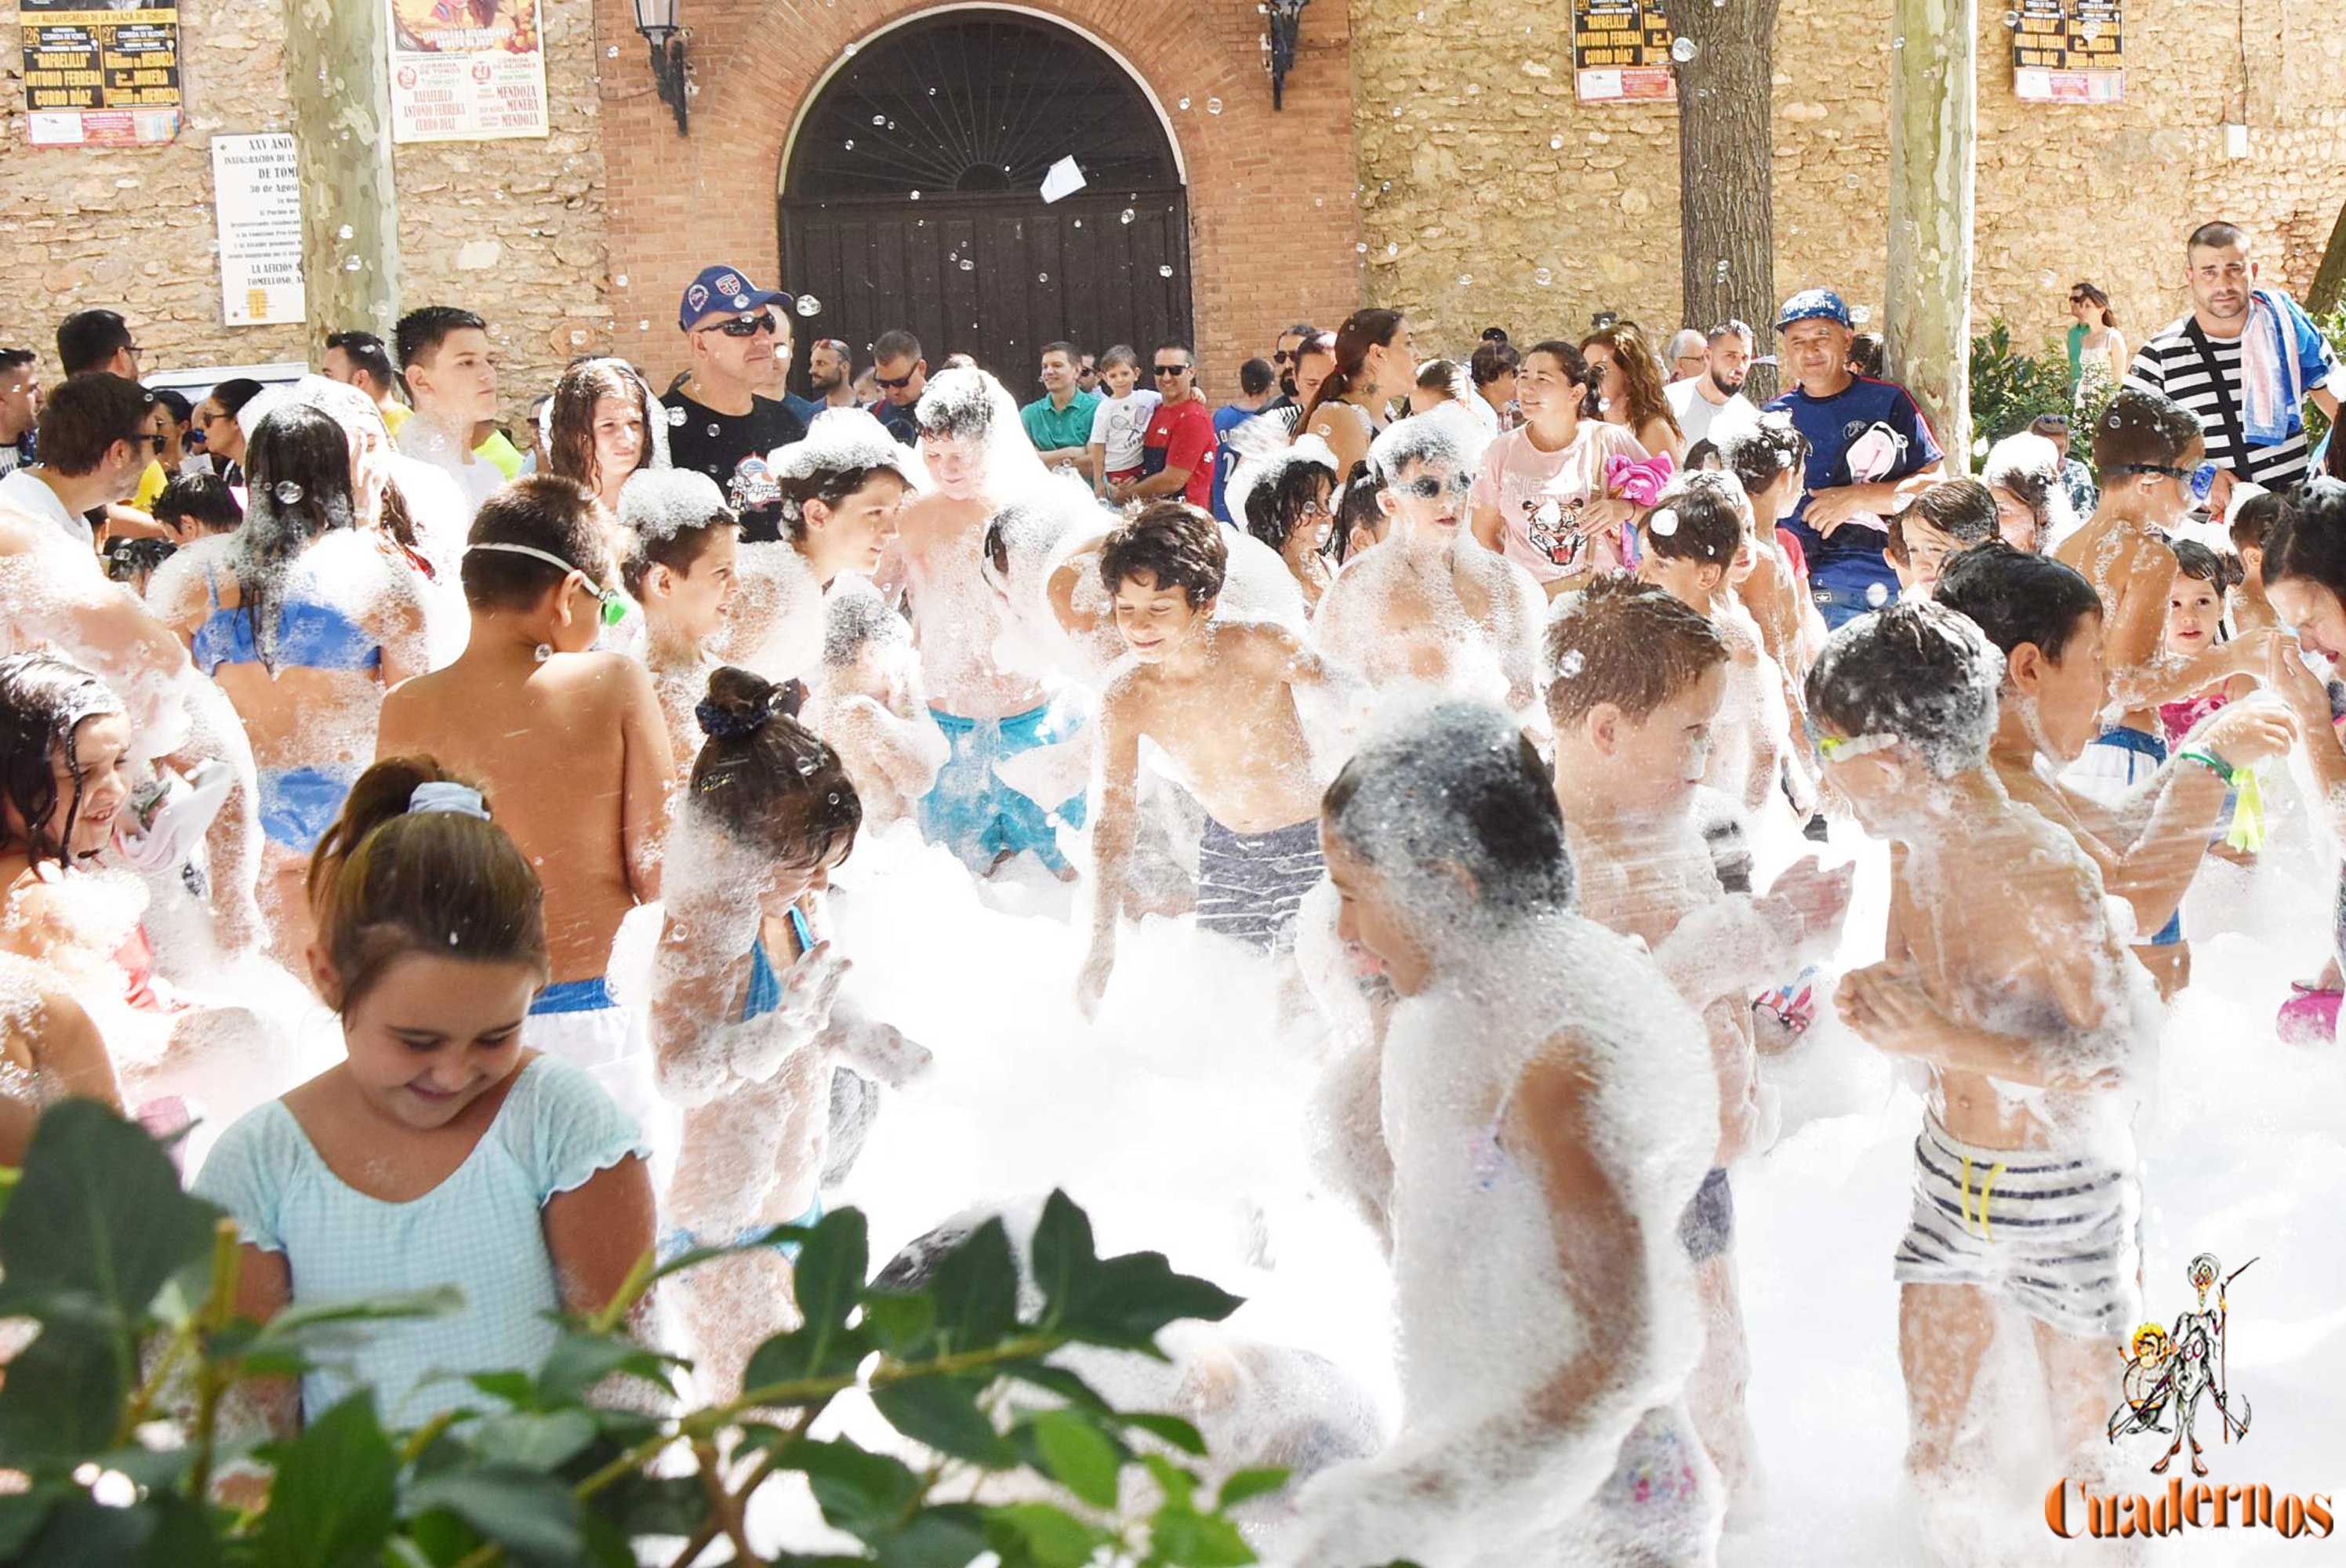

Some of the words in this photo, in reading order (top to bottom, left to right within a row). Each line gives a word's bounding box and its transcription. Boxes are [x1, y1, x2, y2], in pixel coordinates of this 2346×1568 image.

[1577, 31, 1609, 47] ANTONIO
[1610, 30, 1642, 46] FERRERA
[1585, 49, 1614, 64] CURRO
[1614, 46, 1633, 63] DÍAZ
[26, 71, 63, 87] ANTONIO
[64, 70, 102, 86] FERRERA
[34, 89, 68, 106] CURRO
[69, 87, 93, 105] DÍAZ
[496, 85, 536, 99] MENDOZA
[404, 104, 434, 118] ANTONIO
[434, 103, 467, 117] FERRERA
[416, 119, 438, 132] CURRO
[502, 112, 539, 126] MENDOZA
[249, 139, 267, 151] XXV
[277, 154, 285, 162] DE
[258, 168, 271, 180] DE
[251, 264, 261, 274] LA
